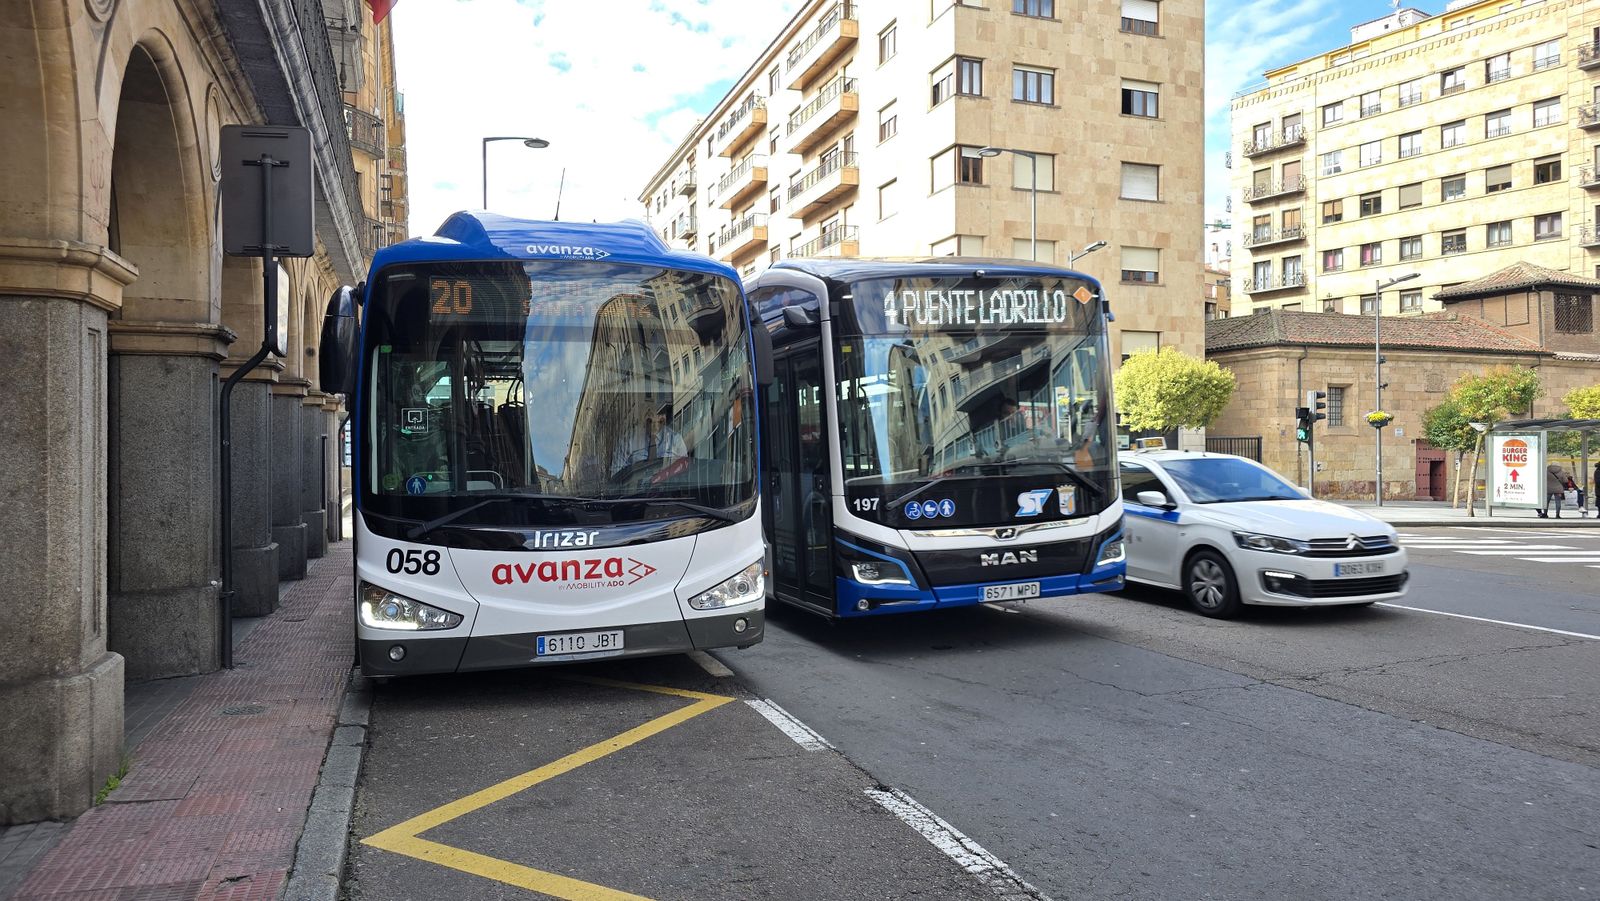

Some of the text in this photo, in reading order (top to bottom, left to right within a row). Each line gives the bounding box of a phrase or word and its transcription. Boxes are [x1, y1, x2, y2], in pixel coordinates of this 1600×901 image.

[526, 244, 594, 256] avanza
[432, 280, 473, 314] 20
[884, 289, 1066, 324] 4 PUENTE LADRILLO
[1502, 454, 1528, 462] KING
[1510, 483, 1526, 491] MIN.
[853, 497, 880, 512] 197
[534, 530, 600, 548] Irizar
[386, 548, 441, 575] 058
[980, 549, 1038, 567] MAN
[491, 557, 625, 585] avanza
[566, 581, 606, 590] MOBILITY
[606, 580, 625, 588] ADO
[986, 584, 1037, 599] 6571 MPD
[549, 636, 585, 652] 6110
[593, 633, 618, 648] JBT
